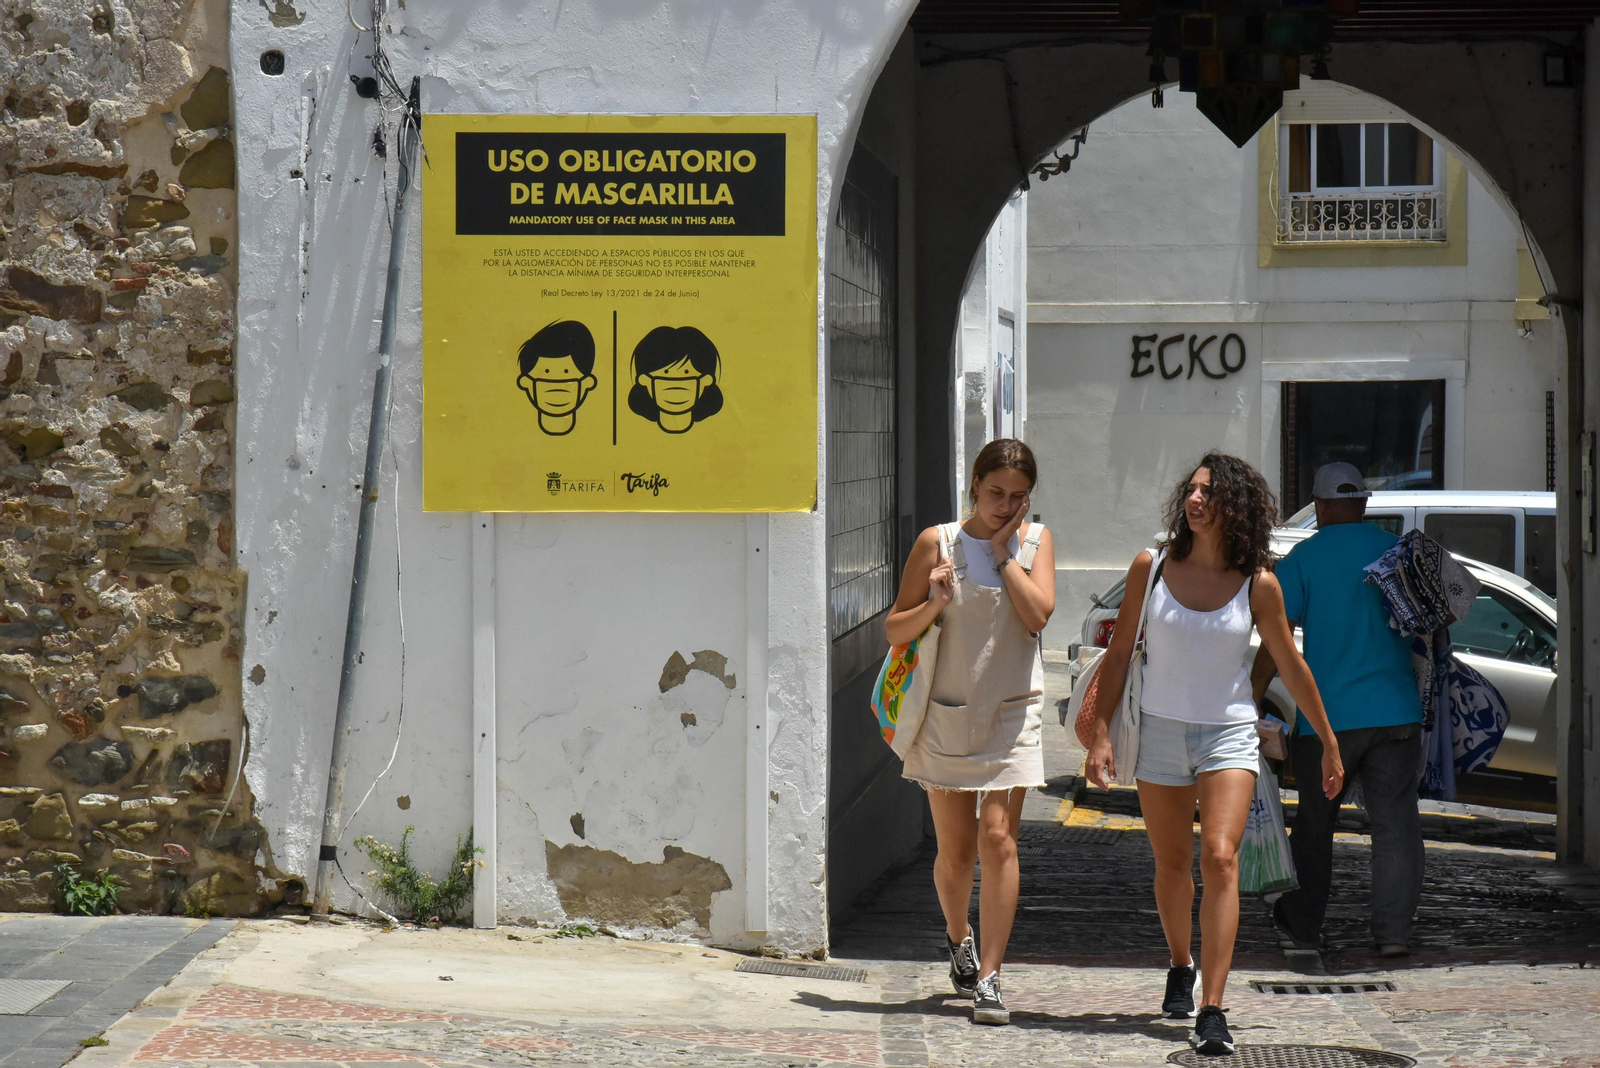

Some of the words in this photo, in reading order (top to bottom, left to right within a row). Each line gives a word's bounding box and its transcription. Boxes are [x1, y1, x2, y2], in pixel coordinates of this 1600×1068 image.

[488, 149, 549, 173] USO
[559, 149, 757, 173] OBLIGATORIO
[510, 182, 544, 205] DE
[555, 182, 735, 205] MASCARILLA
[509, 216, 573, 225] MANDATORY
[576, 216, 594, 225] USE
[597, 216, 611, 225] OF
[613, 216, 637, 225] FACE
[639, 216, 669, 225] MASK
[671, 217, 683, 225] IN
[685, 217, 707, 225] THIS
[709, 217, 736, 225] AREA
[493, 247, 513, 257] ESTÁ
[516, 249, 541, 257] USTED
[543, 249, 600, 257] ACCEDIENDO
[610, 249, 651, 257] ESPACIOS
[653, 248, 692, 258] PÚBLICOS
[694, 250, 707, 258] EN
[709, 250, 725, 258] LOS
[727, 250, 745, 258] QUE
[483, 259, 500, 267] POR
[502, 259, 512, 267] LA
[514, 258, 584, 267] AGLOMERACIÓN
[586, 259, 597, 267] DE
[600, 260, 644, 268] PERSONAS
[646, 260, 661, 268] NO
[663, 260, 673, 268] ES
[675, 260, 707, 268] POSIBLE
[709, 260, 756, 268] MANTENER
[508, 269, 518, 277] LA
[521, 269, 565, 277] DISTANCIA
[567, 268, 600, 277] MÍNIMA
[602, 269, 613, 277] DE
[615, 270, 663, 278] SEGURIDAD
[665, 270, 731, 278] INTERPERSONAL
[541, 289, 559, 298] (Real
[561, 289, 589, 297] Decreto
[591, 290, 603, 298] Ley
[606, 289, 640, 298] 13/2021
[642, 289, 653, 298] de
[654, 290, 665, 298] 24
[667, 290, 677, 298] de
[678, 289, 700, 299] Junio)
[1130, 332, 1247, 381] ECKO
[562, 482, 605, 493] TARIFA
[620, 472, 670, 497] Tarifa
